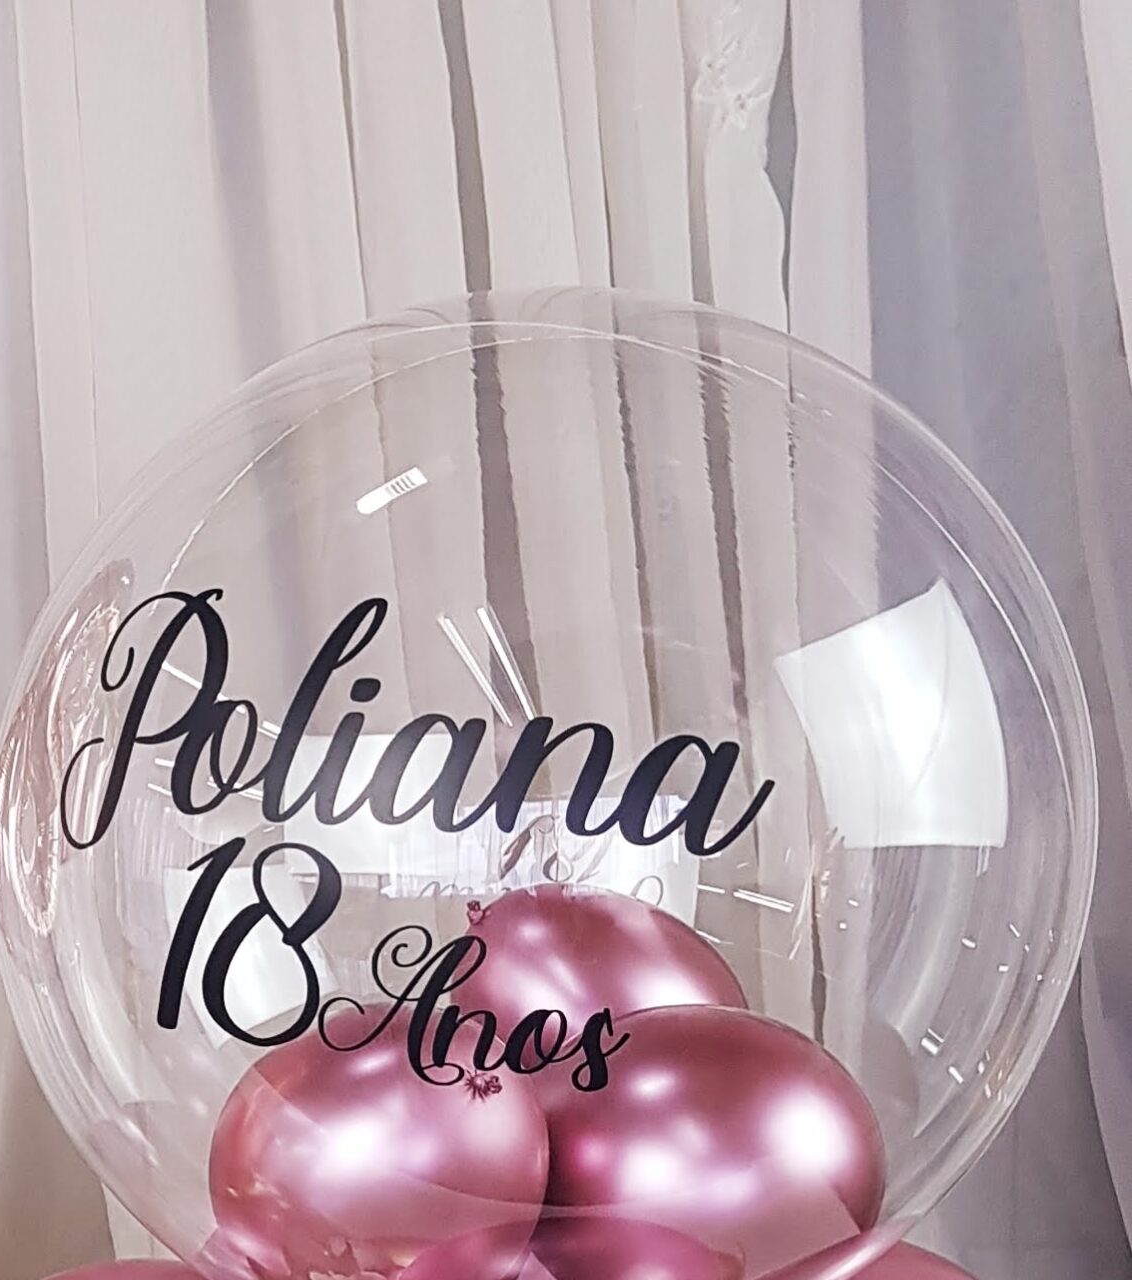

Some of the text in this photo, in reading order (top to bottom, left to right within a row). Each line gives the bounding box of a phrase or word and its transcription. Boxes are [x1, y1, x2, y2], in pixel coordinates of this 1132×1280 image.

[61, 587, 774, 855] Poliana
[157, 837, 342, 1047] 18
[319, 925, 630, 1092] Anos
